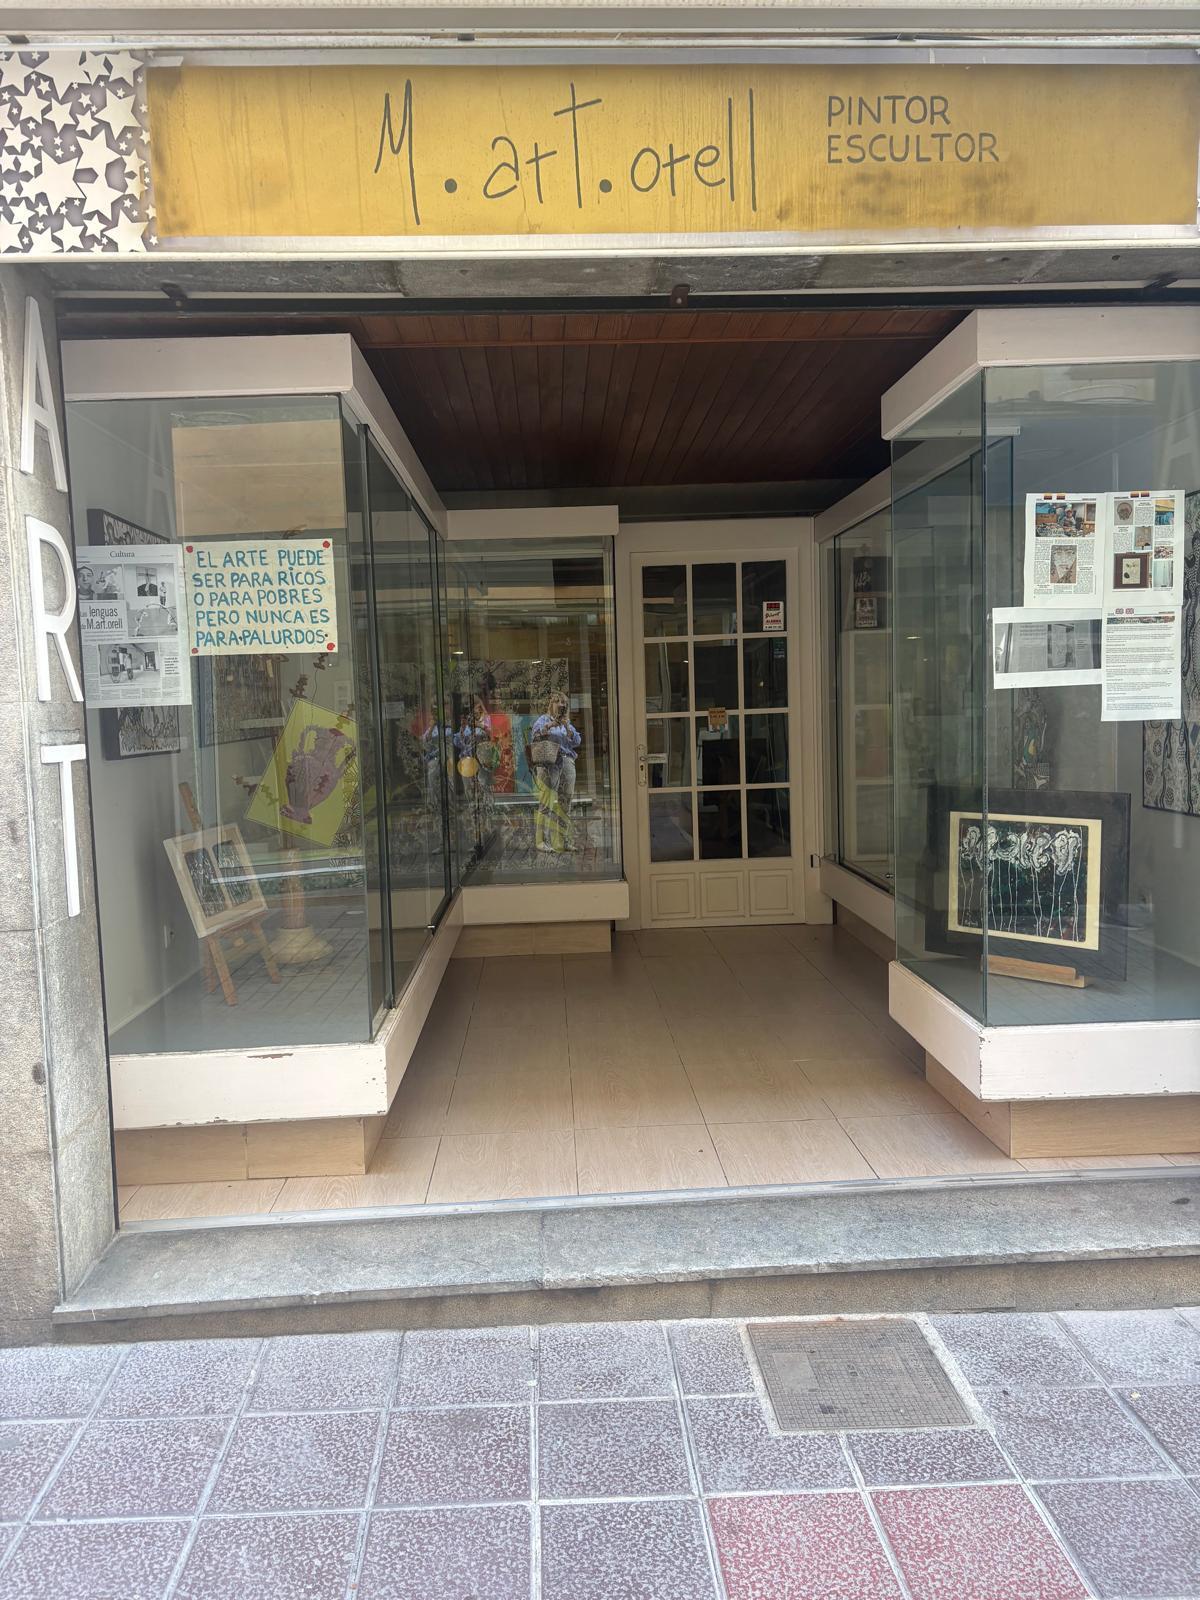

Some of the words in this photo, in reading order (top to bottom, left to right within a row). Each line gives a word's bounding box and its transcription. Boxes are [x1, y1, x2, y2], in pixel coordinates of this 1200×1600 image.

[827, 95, 951, 127] PINTOR
[827, 132, 1000, 164] ESCULTOR
[197, 550, 218, 568] EL
[223, 550, 269, 568] ARTE
[278, 549, 325, 567] PUEDE
[192, 572, 226, 588] SER
[230, 572, 273, 588] PARA
[20, 296, 86, 918] ART
[193, 592, 205, 606] O
[209, 591, 253, 607] PARA
[257, 588, 323, 607] POBRES
[88, 605, 119, 620] lenguas
[196, 610, 240, 627] PERO
[246, 609, 305, 624] NUNCA
[310, 609, 330, 624] ES
